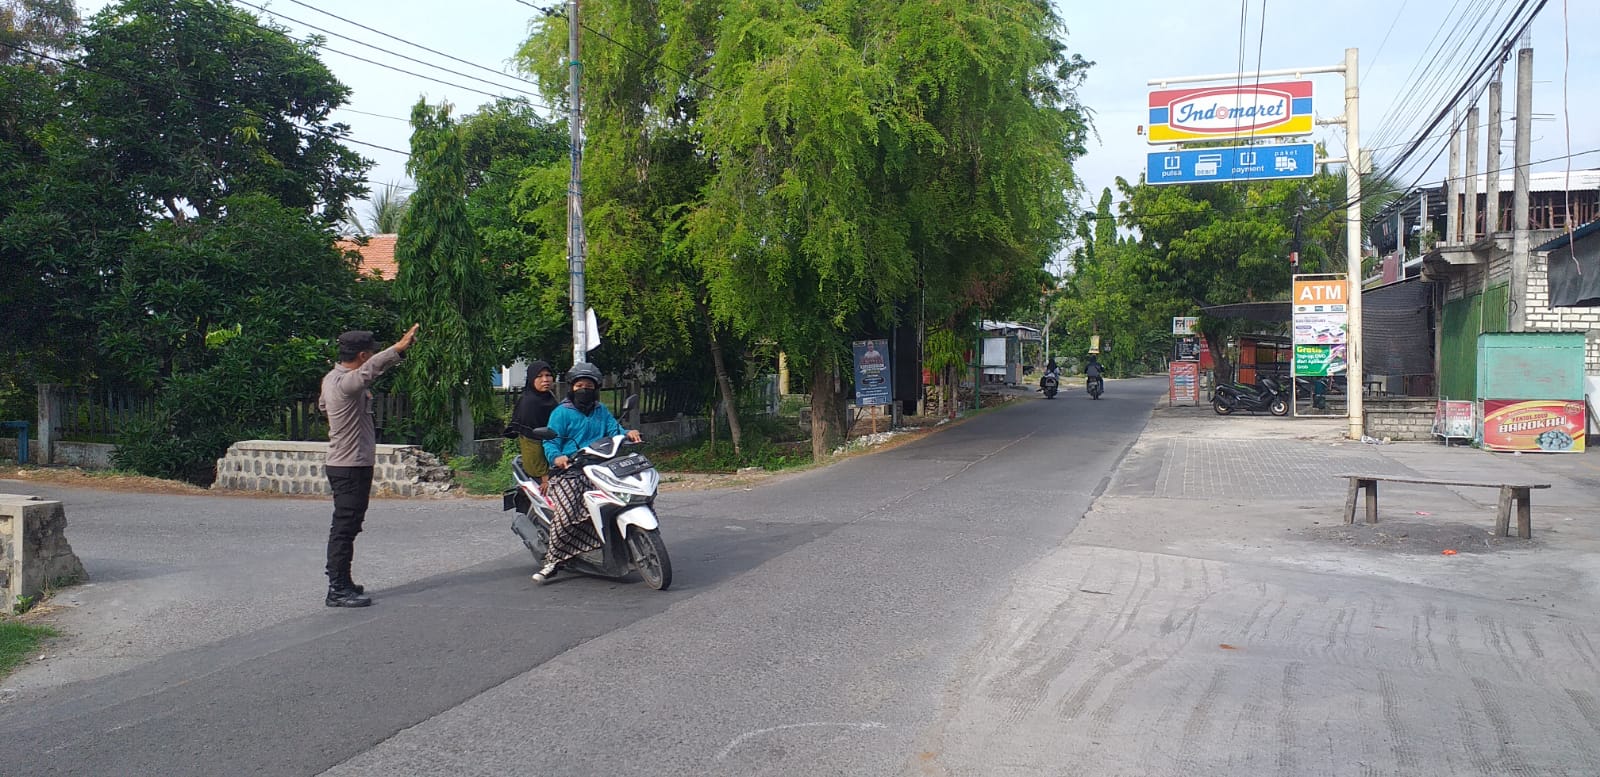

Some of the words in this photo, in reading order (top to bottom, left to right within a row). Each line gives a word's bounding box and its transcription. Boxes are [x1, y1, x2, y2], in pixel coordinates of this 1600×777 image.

[1177, 99, 1284, 123] Indomaret
[1161, 170, 1183, 179] pulsa
[1231, 165, 1265, 174] payment
[1300, 285, 1342, 301] ATM
[1499, 416, 1567, 433] BAROKAH
